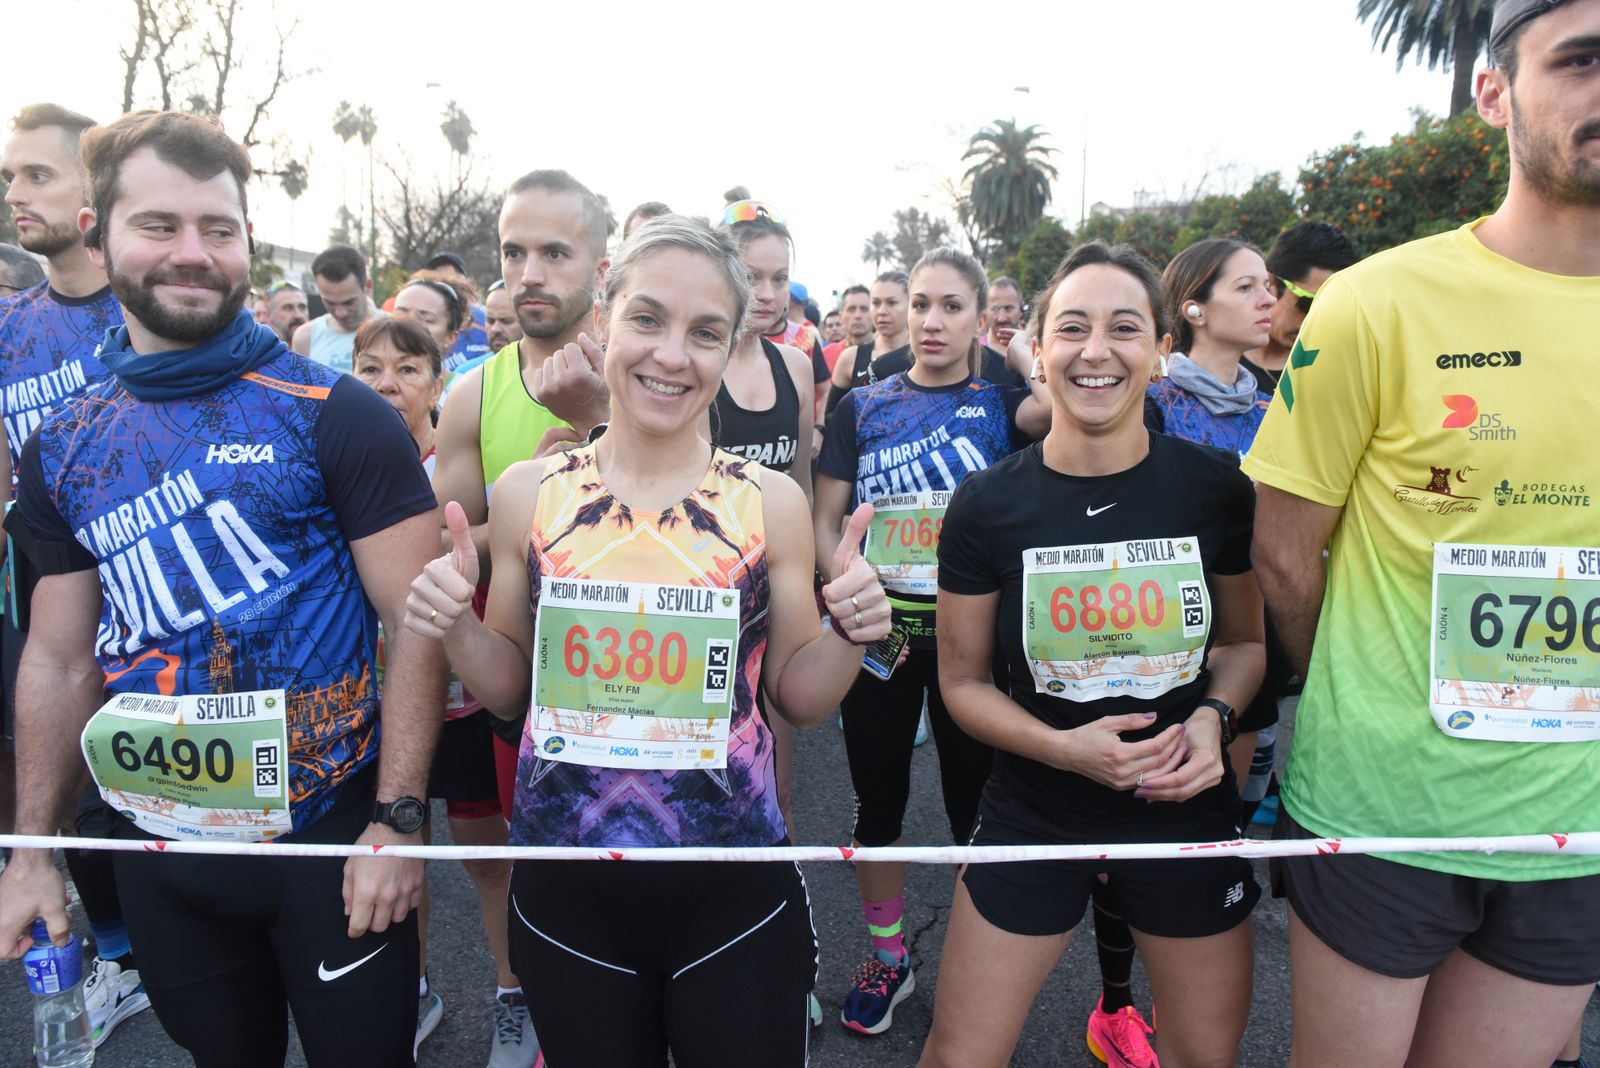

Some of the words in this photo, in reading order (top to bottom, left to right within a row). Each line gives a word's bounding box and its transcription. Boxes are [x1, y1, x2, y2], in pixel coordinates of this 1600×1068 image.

[1436, 351, 1502, 369] emec
[6, 359, 87, 414] MARATÓN
[1479, 413, 1502, 428] DS
[1469, 426, 1516, 441] Smith
[205, 444, 274, 464] HOKA
[723, 435, 797, 465] PAÑA
[1522, 484, 1585, 493] BODEGAS
[891, 495, 917, 506] MARATÓN
[932, 492, 952, 505] SEVI
[1512, 494, 1527, 504] EL
[1532, 494, 1590, 507] MONTE
[90, 469, 204, 558] MARATÓN
[1035, 551, 1060, 566] MEDIO
[1063, 546, 1104, 564] MARATÓN
[1126, 540, 1176, 563] SEVILLA
[1450, 548, 1486, 566] MEDIO
[1491, 548, 1547, 568] MARATÓN
[255, 581, 296, 616] EDICIÓN
[550, 581, 577, 600] MEDIO
[581, 584, 629, 603] MARATÓN
[656, 586, 713, 613] SEVILLA
[1050, 579, 1165, 634] 6880
[1470, 592, 1600, 654] 6796
[1088, 633, 1133, 643] SILVIDITO
[563, 624, 688, 685] 6380
[1506, 653, 1577, 665] Núñez-Flores
[605, 684, 623, 694] ELY
[625, 685, 640, 695] FM
[1107, 679, 1133, 688] HOKA
[1513, 675, 1571, 685] Núñez-Flores
[116, 696, 140, 711] MEDIO
[141, 698, 179, 716] MARATÓN
[196, 695, 256, 720] SEVILLA
[586, 704, 626, 714] Fernandez
[628, 706, 655, 716] Macias
[1531, 718, 1561, 729] HOKA
[111, 731, 234, 783] 6490
[609, 746, 639, 757] HOKA
[176, 825, 202, 838] HOKA
